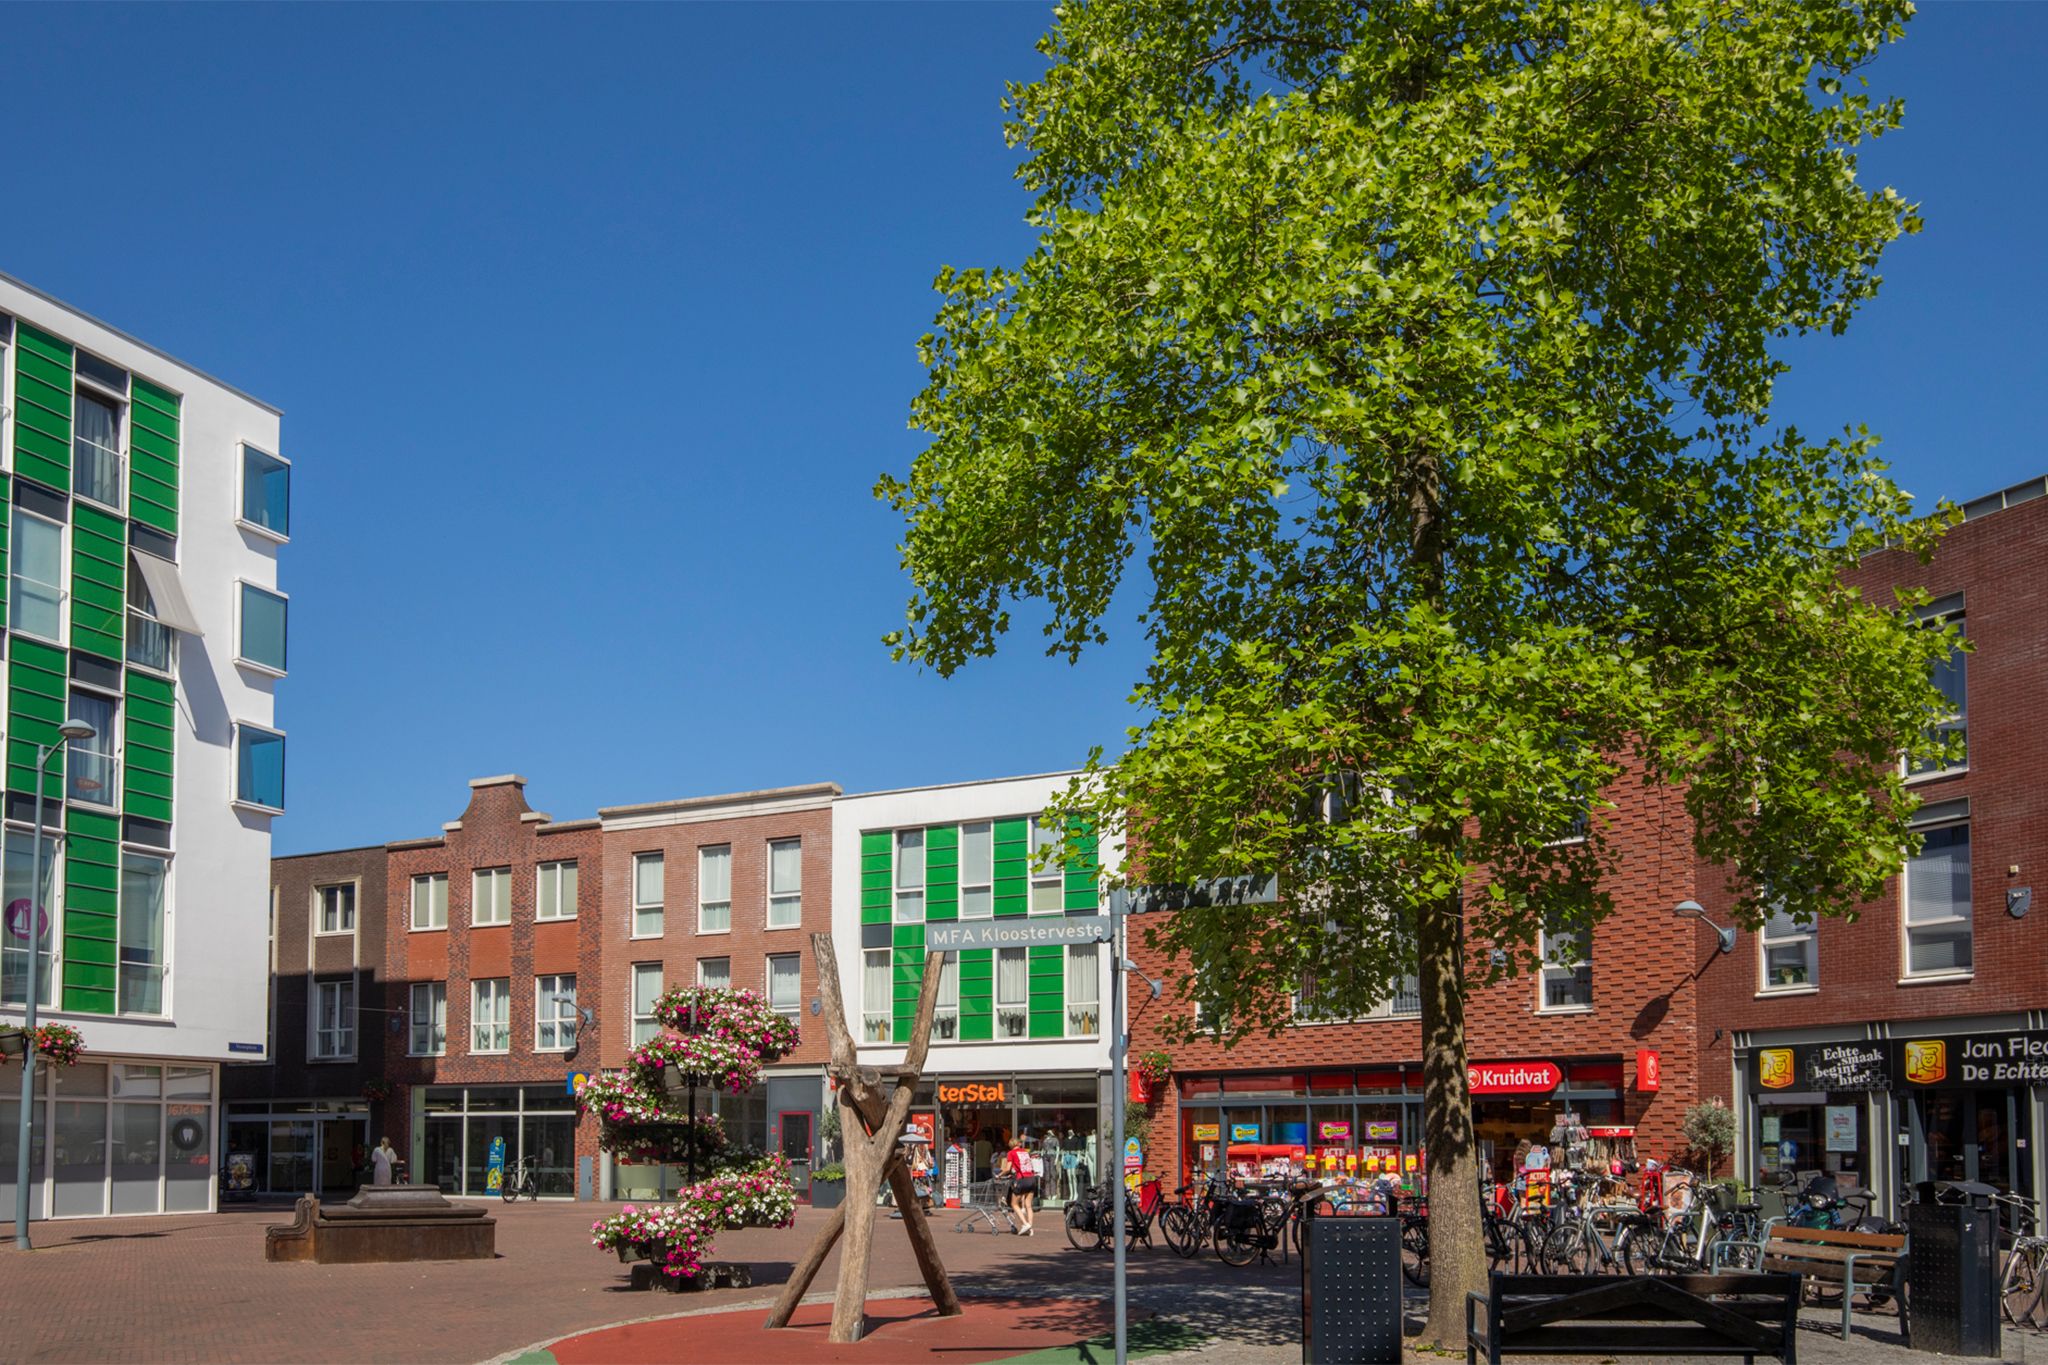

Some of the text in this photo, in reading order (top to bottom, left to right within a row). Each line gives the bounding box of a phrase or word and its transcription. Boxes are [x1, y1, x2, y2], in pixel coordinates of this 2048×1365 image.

[934, 924, 1103, 944] MFA Kloosterveste
[1822, 1046, 1859, 1060] Echte
[1841, 1048, 1884, 1065] smaak
[1962, 1040, 2003, 1058] Jan
[1482, 1068, 1550, 1086] Kruidvat
[1814, 1063, 1858, 1078] begint
[1839, 1070, 1871, 1086] hier!
[1962, 1062, 2048, 1080] De Echte
[938, 1082, 1005, 1102] terStal
